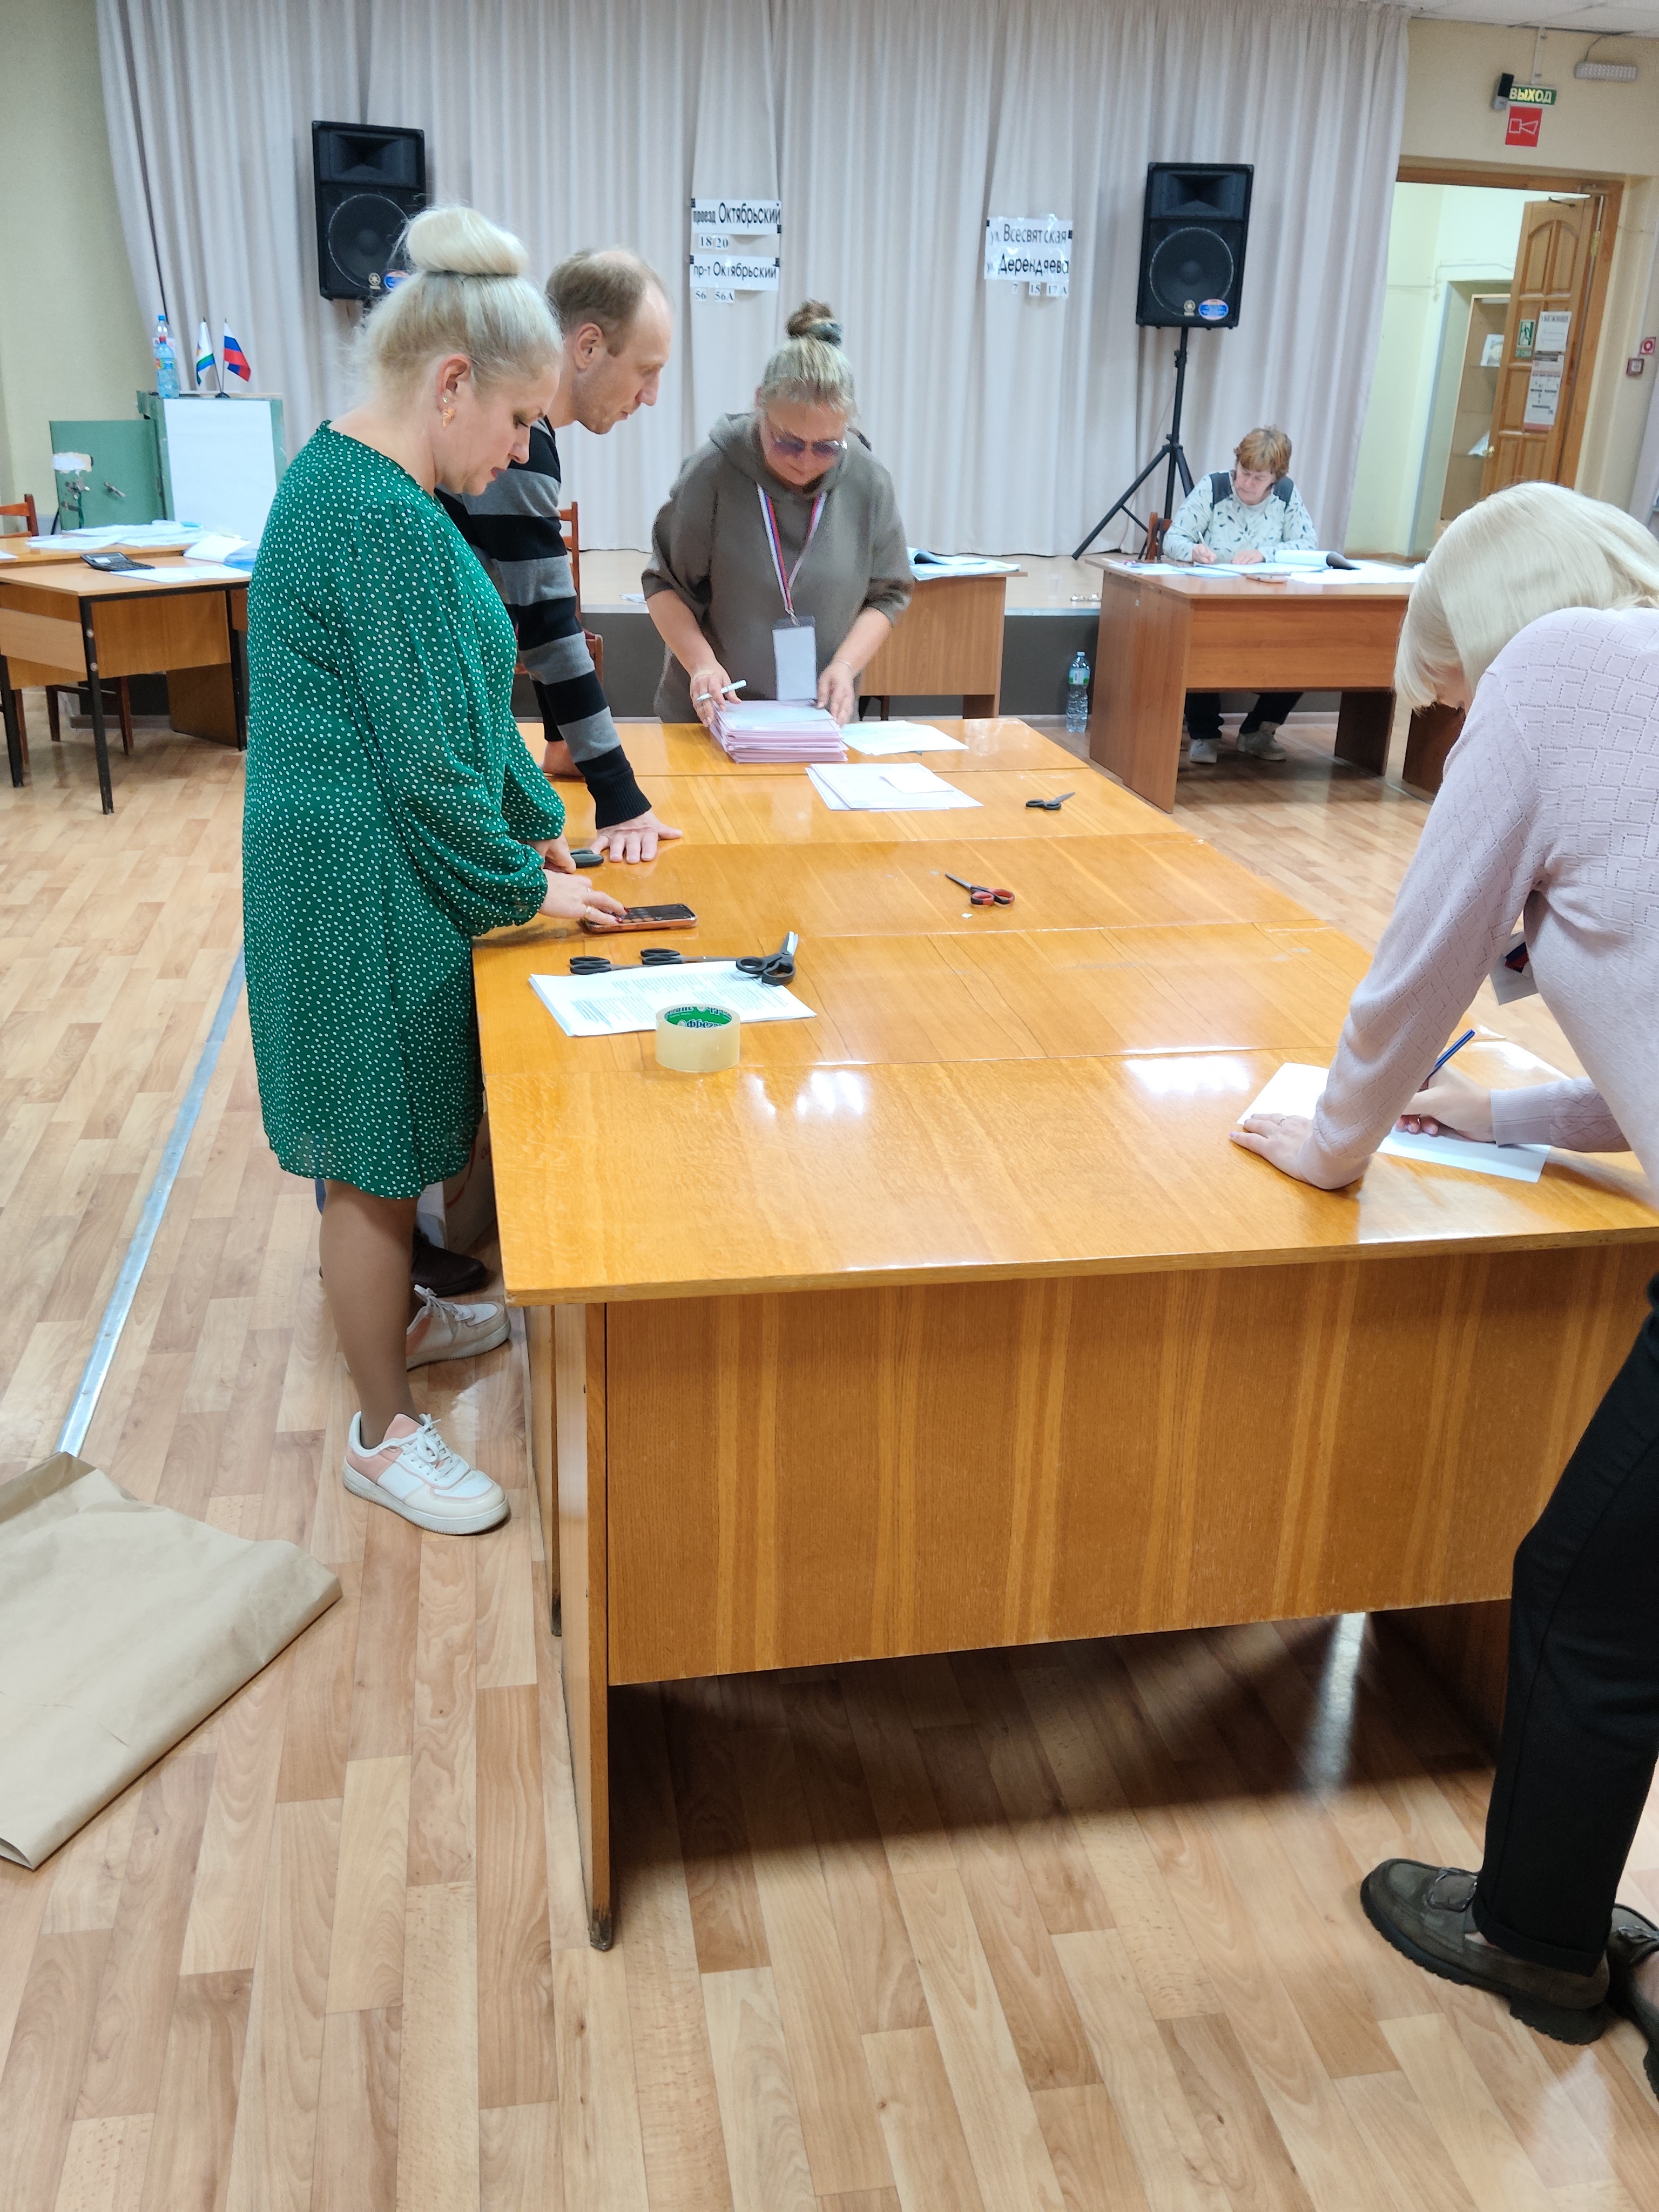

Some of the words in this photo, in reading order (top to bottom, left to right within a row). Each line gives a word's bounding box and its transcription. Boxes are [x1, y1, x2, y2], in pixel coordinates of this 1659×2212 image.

[1509, 87, 1552, 104] ВЫХОД
[718, 202, 781, 228] Октябрьский
[700, 236, 712, 247] 18
[716, 238, 729, 248] 20
[1003, 224, 1067, 244] Всесвятская
[693, 265, 711, 278] пр-т
[713, 261, 777, 281] Октябрьский
[998, 253, 1069, 276] Дерендяева
[694, 290, 706, 300] 56
[1013, 283, 1018, 292] 7
[1031, 285, 1041, 293] 15
